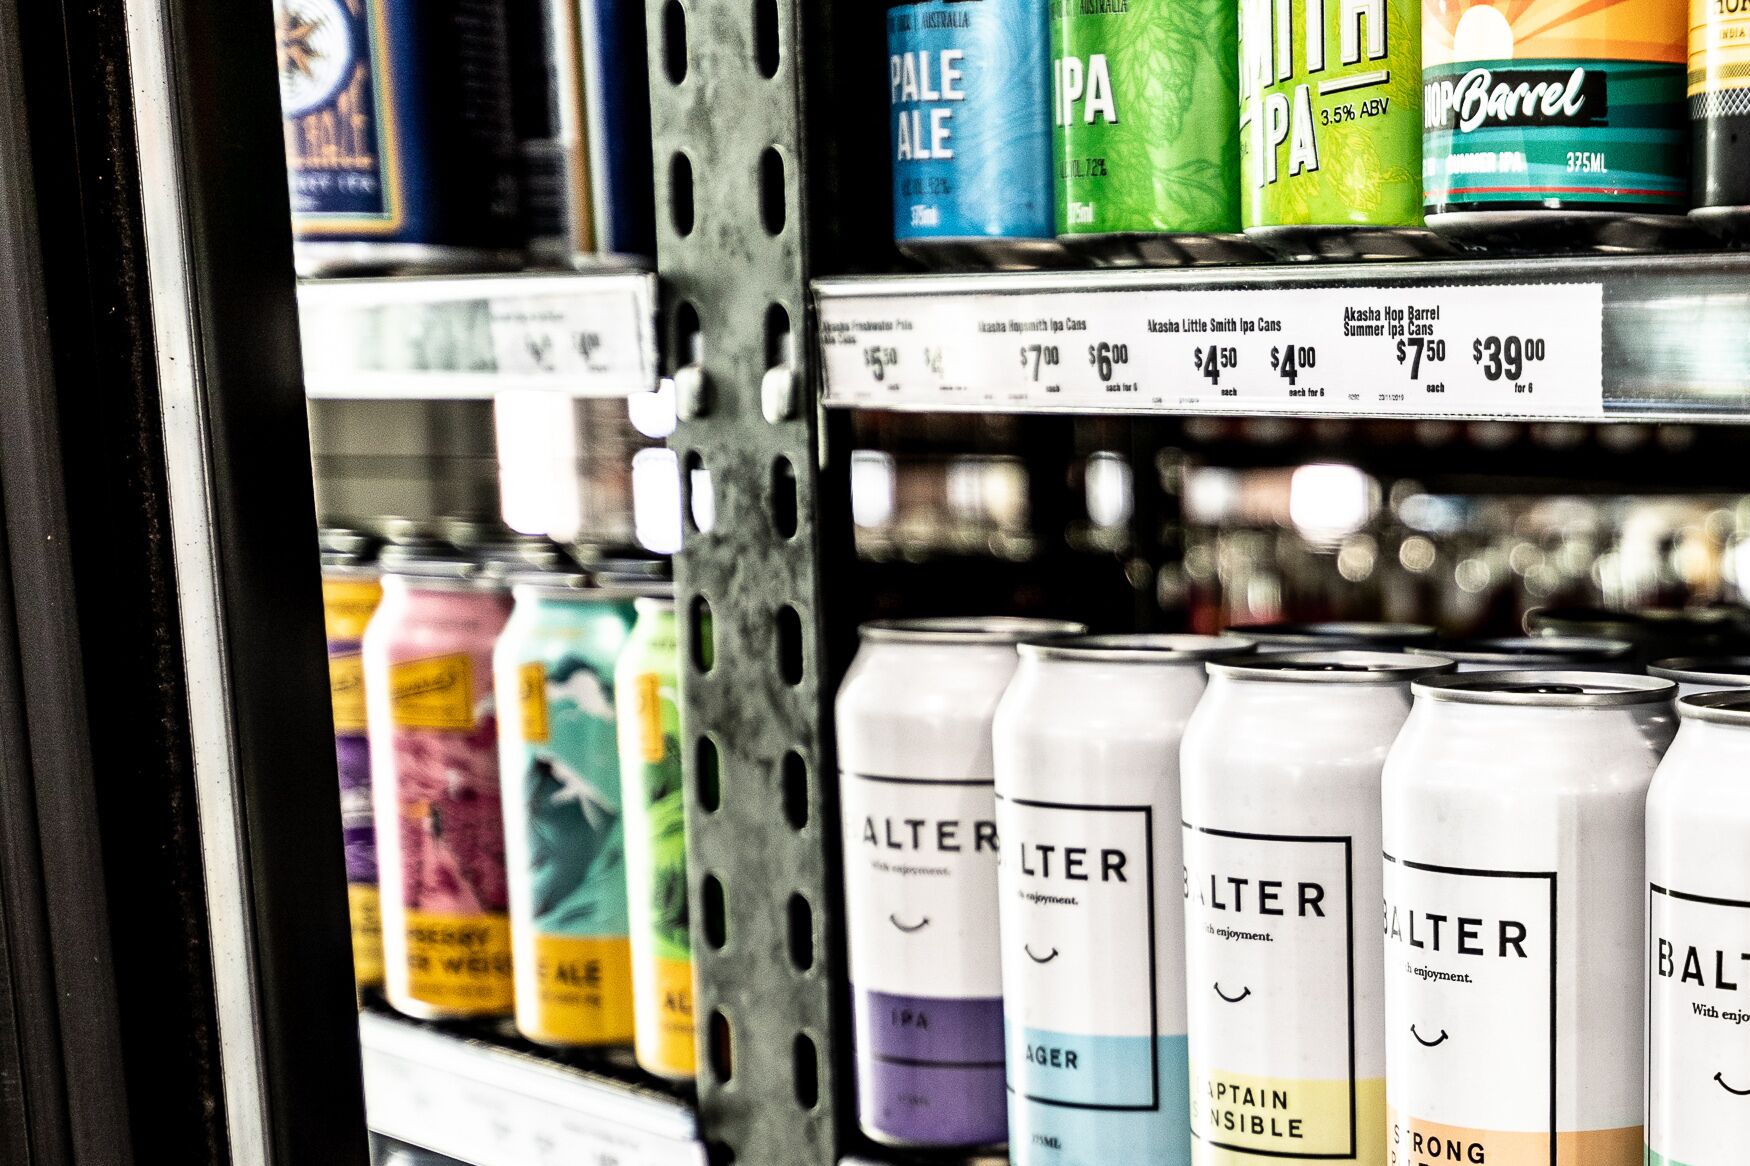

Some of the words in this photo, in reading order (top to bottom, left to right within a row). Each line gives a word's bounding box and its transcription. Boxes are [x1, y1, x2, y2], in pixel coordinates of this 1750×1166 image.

[891, 49, 965, 103] PALE
[1054, 53, 1119, 127] IPA
[1424, 82, 1452, 128] HOP
[1453, 66, 1586, 133] Barrel
[1320, 102, 1356, 127] 3.5%
[1359, 97, 1390, 119] ABV
[897, 108, 954, 160] ALE
[1254, 83, 1320, 189] IPA
[1499, 151, 1524, 173] IPA
[1566, 150, 1608, 174] 375ML
[979, 319, 1007, 333] Akasha
[1008, 318, 1048, 334] Hopsmith
[1050, 319, 1064, 333] Ipa
[1066, 317, 1087, 331] Cans
[1147, 317, 1180, 335] Akasha
[1181, 317, 1208, 334] Little
[1209, 316, 1238, 334] Smith
[1239, 317, 1255, 336] Ipa
[1257, 315, 1282, 333] Cans
[1343, 305, 1382, 323] Akasha
[1384, 305, 1405, 324] Hop
[1407, 304, 1440, 321] Barrel
[1343, 321, 1386, 338] Summer
[1388, 321, 1405, 340] Ipa
[1407, 320, 1434, 337] Cans
[1020, 344, 1060, 382] $700
[1088, 341, 1129, 382] $600
[1193, 344, 1238, 386] $450
[1270, 344, 1316, 386] $400
[1396, 337, 1446, 381] $750
[1472, 335, 1546, 381] $3900
[1220, 386, 1237, 397] each
[1288, 386, 1306, 397] each
[1307, 386, 1319, 397] for
[1426, 382, 1445, 394] each
[1514, 382, 1526, 393] for
[853, 814, 1000, 855] ALTER
[891, 862, 951, 880] enjoyment.
[1027, 889, 1079, 907] enjoyment.
[1216, 925, 1274, 943] enjoyment.
[1413, 963, 1474, 985] enjoyment.
[889, 1008, 930, 1031] IPA
[1691, 1002, 1720, 1021] With
[1024, 1043, 1079, 1071] AGER
